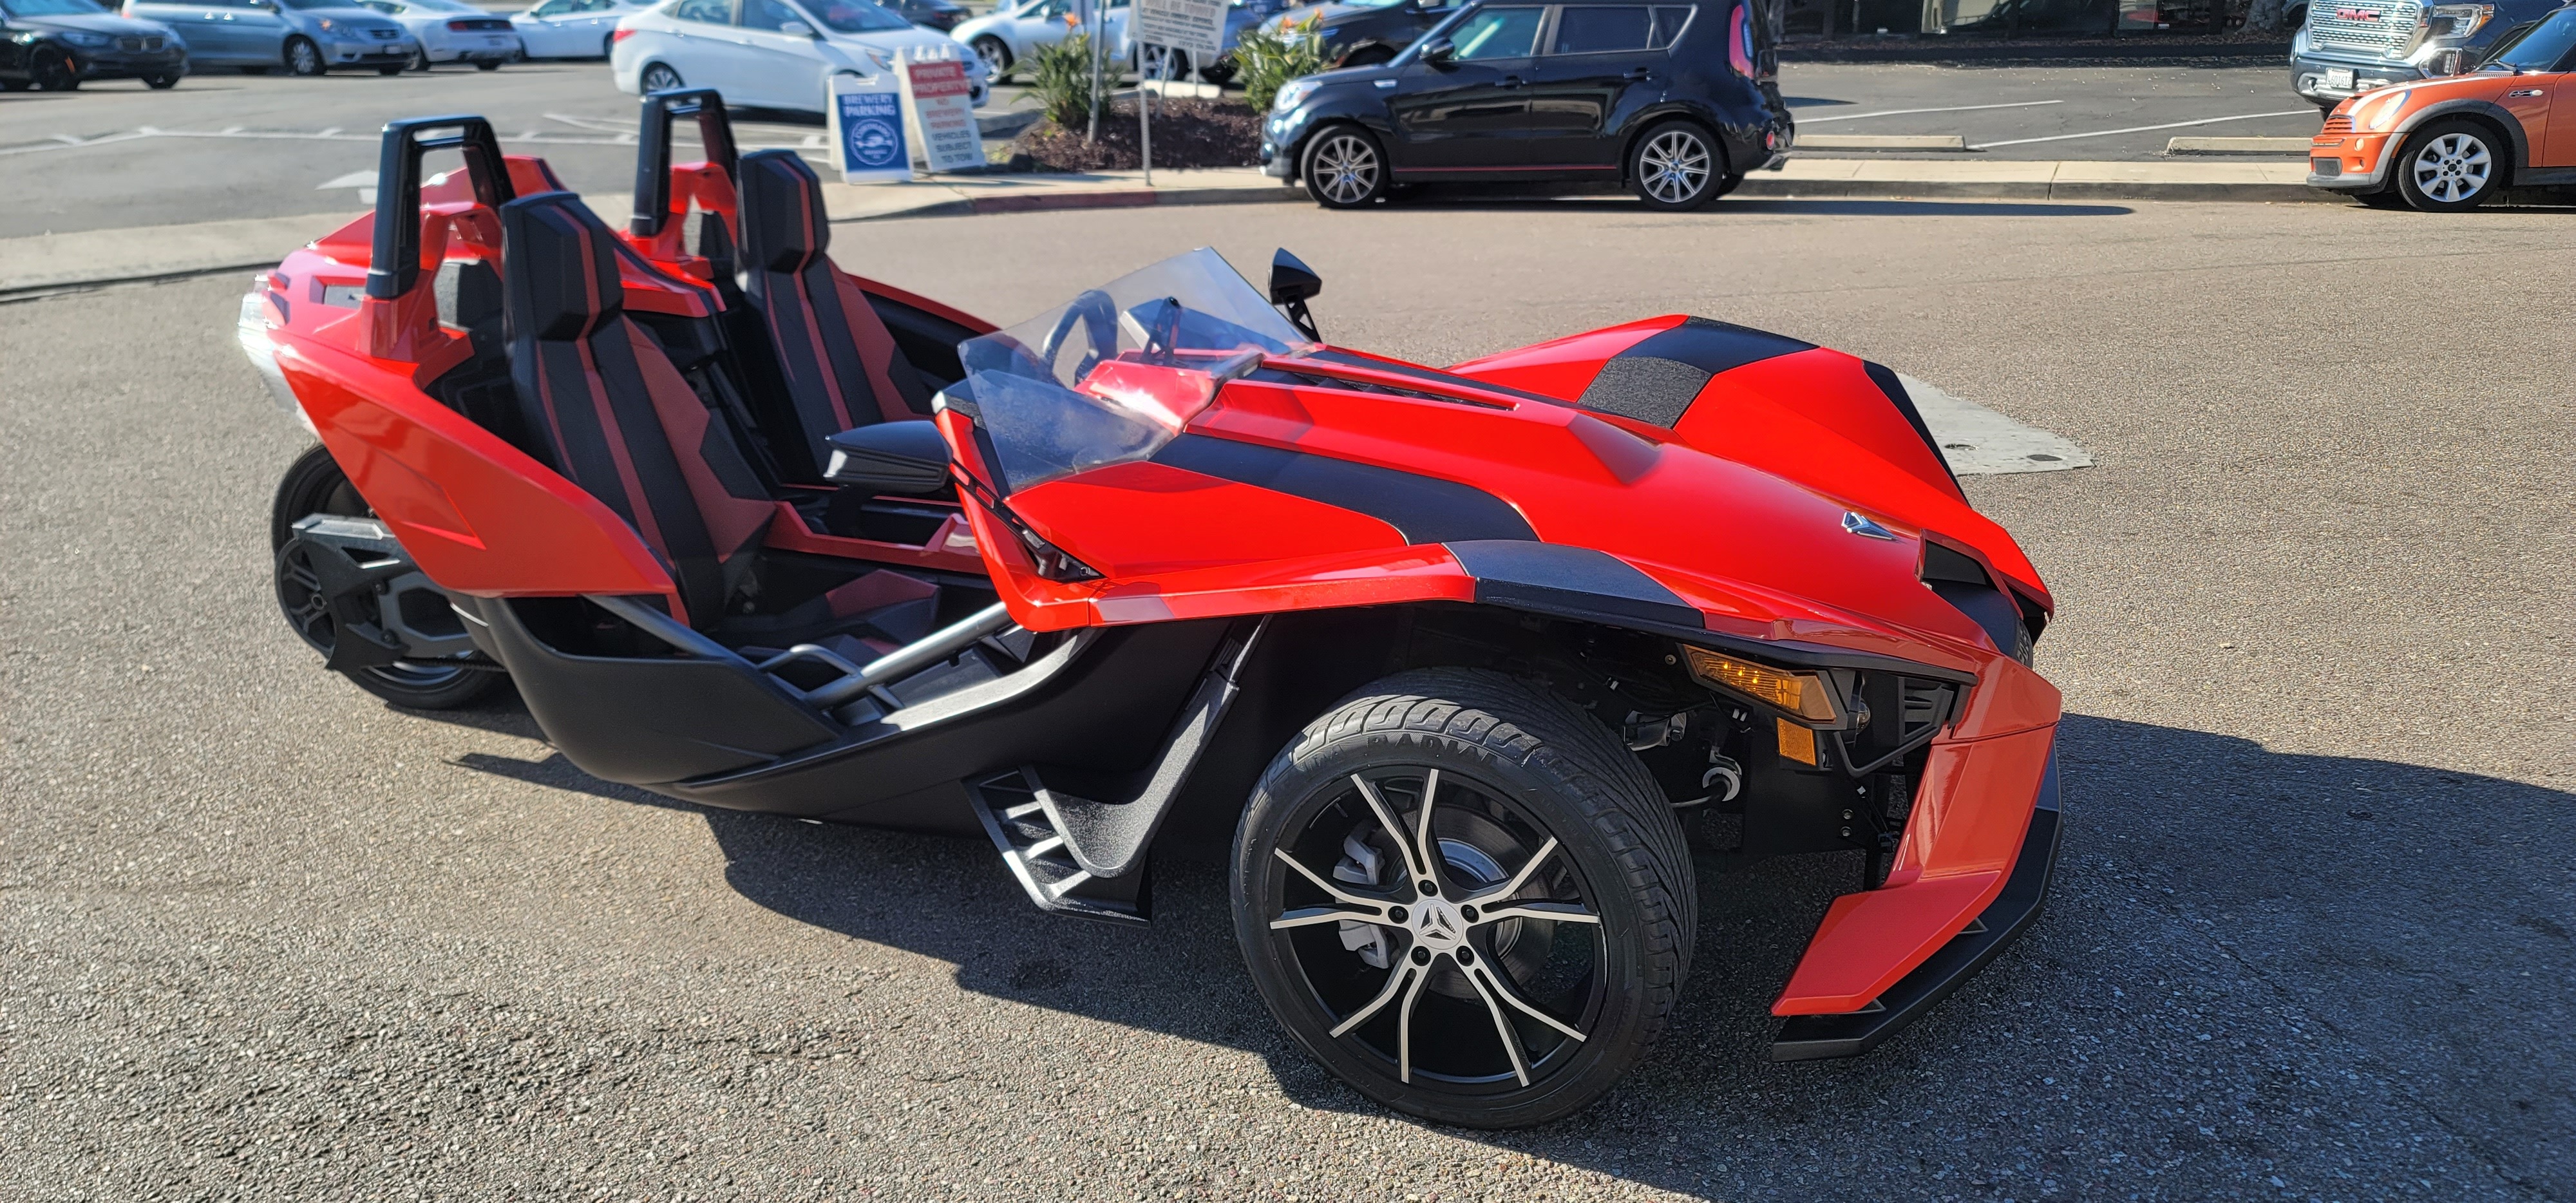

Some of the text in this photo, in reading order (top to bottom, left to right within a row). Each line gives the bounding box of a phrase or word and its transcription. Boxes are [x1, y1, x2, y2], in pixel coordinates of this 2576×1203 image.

[2336, 8, 2381, 21] GMC
[914, 66, 956, 78] PRIVATE
[844, 95, 893, 104] BREWERY
[844, 105, 896, 117] PARKING
[932, 130, 971, 140] VEHICLES
[936, 141, 972, 153] SUBJECT
[942, 153, 972, 162] TO TOW
